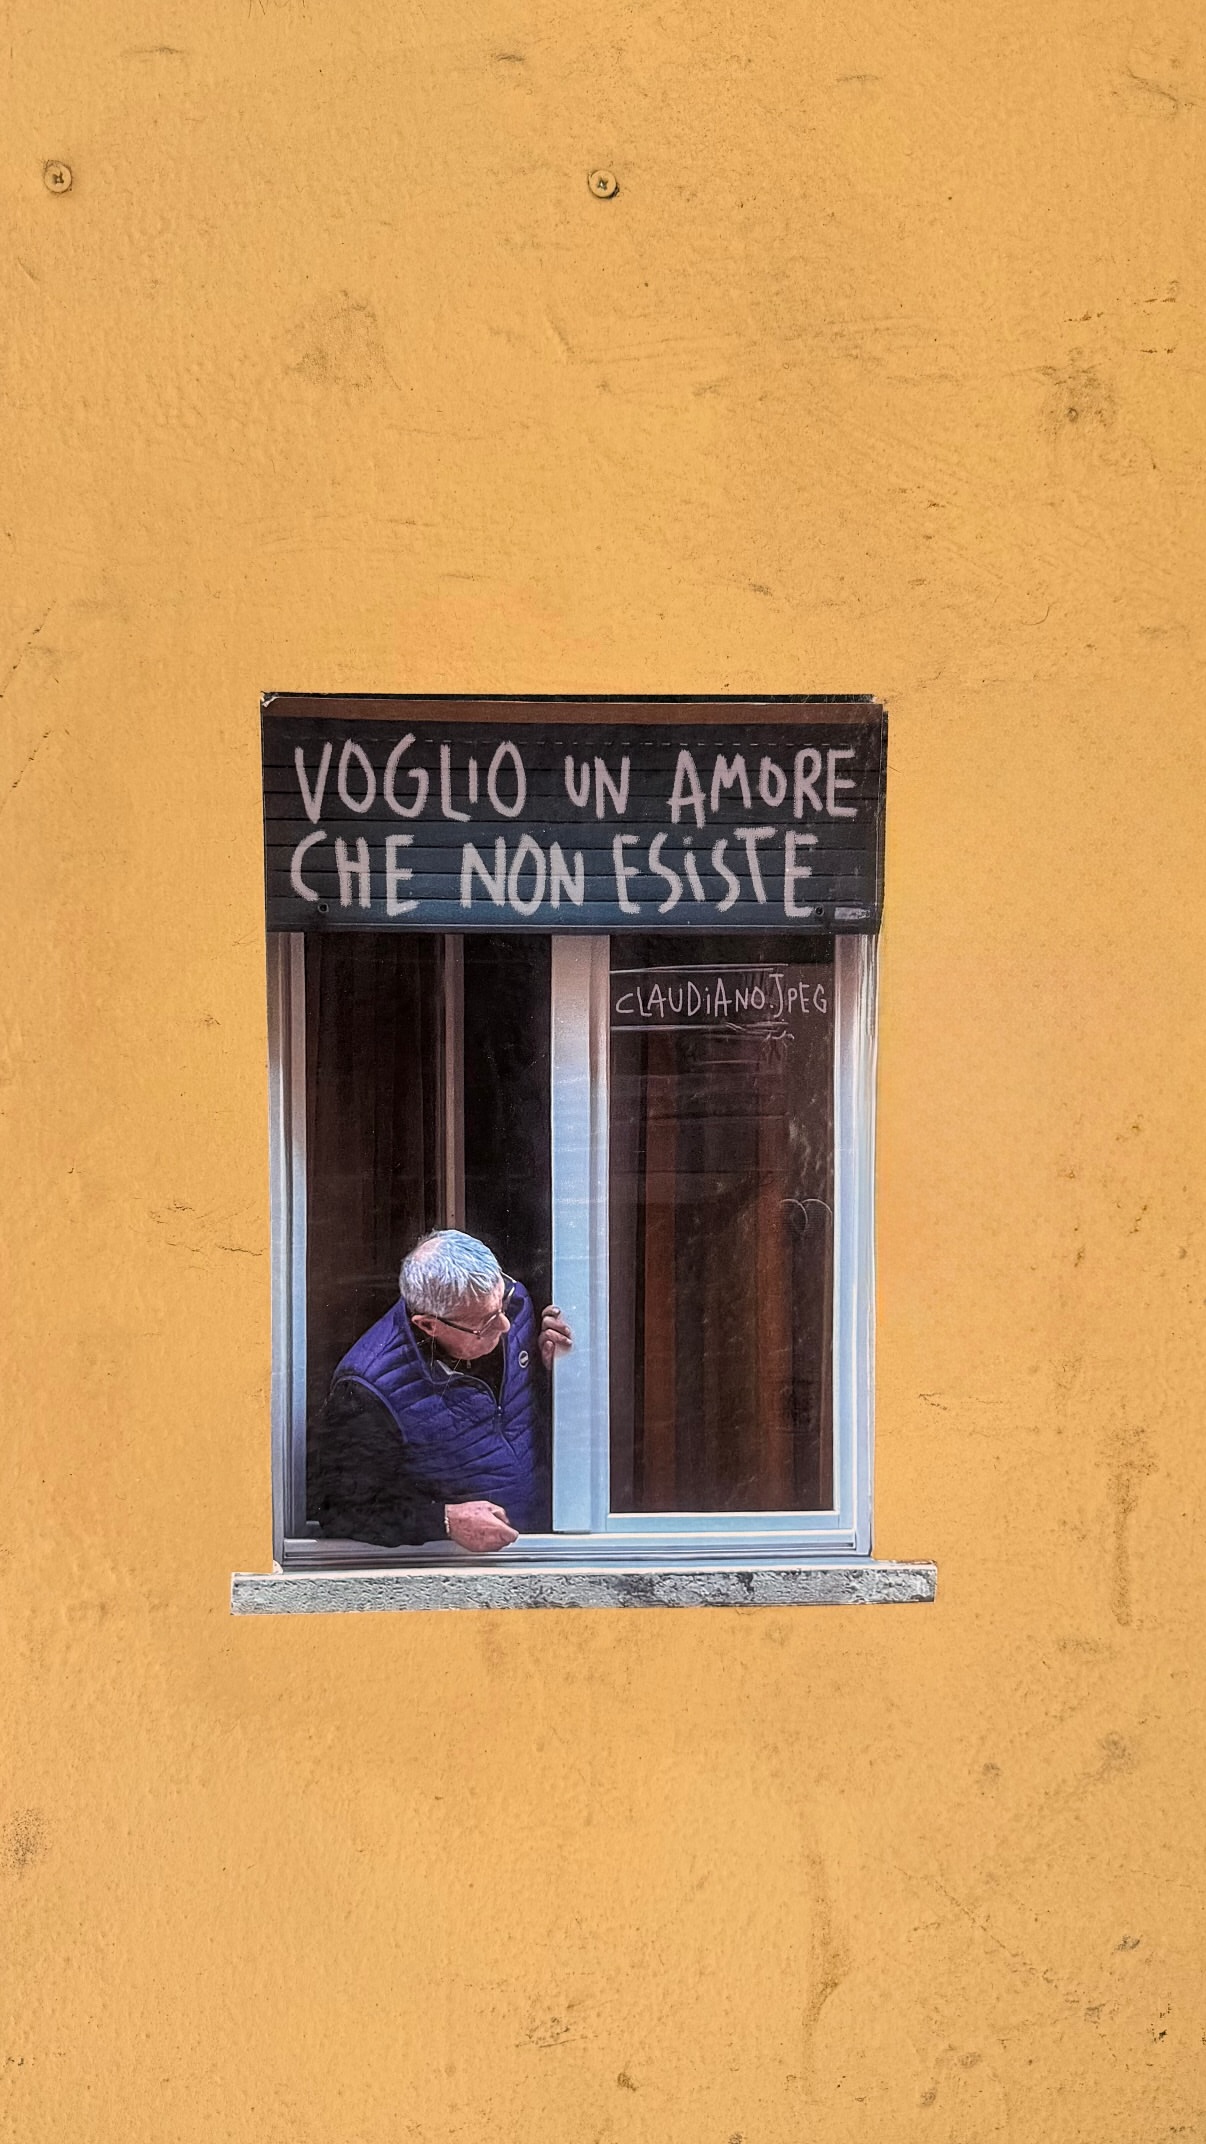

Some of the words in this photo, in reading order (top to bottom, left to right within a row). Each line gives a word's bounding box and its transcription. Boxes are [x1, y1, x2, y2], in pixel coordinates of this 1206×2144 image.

[294, 732, 526, 823] VOGLIO
[564, 754, 630, 818] UN
[666, 747, 858, 828] AMORE
[290, 830, 418, 916] CHE
[460, 833, 584, 915] NON
